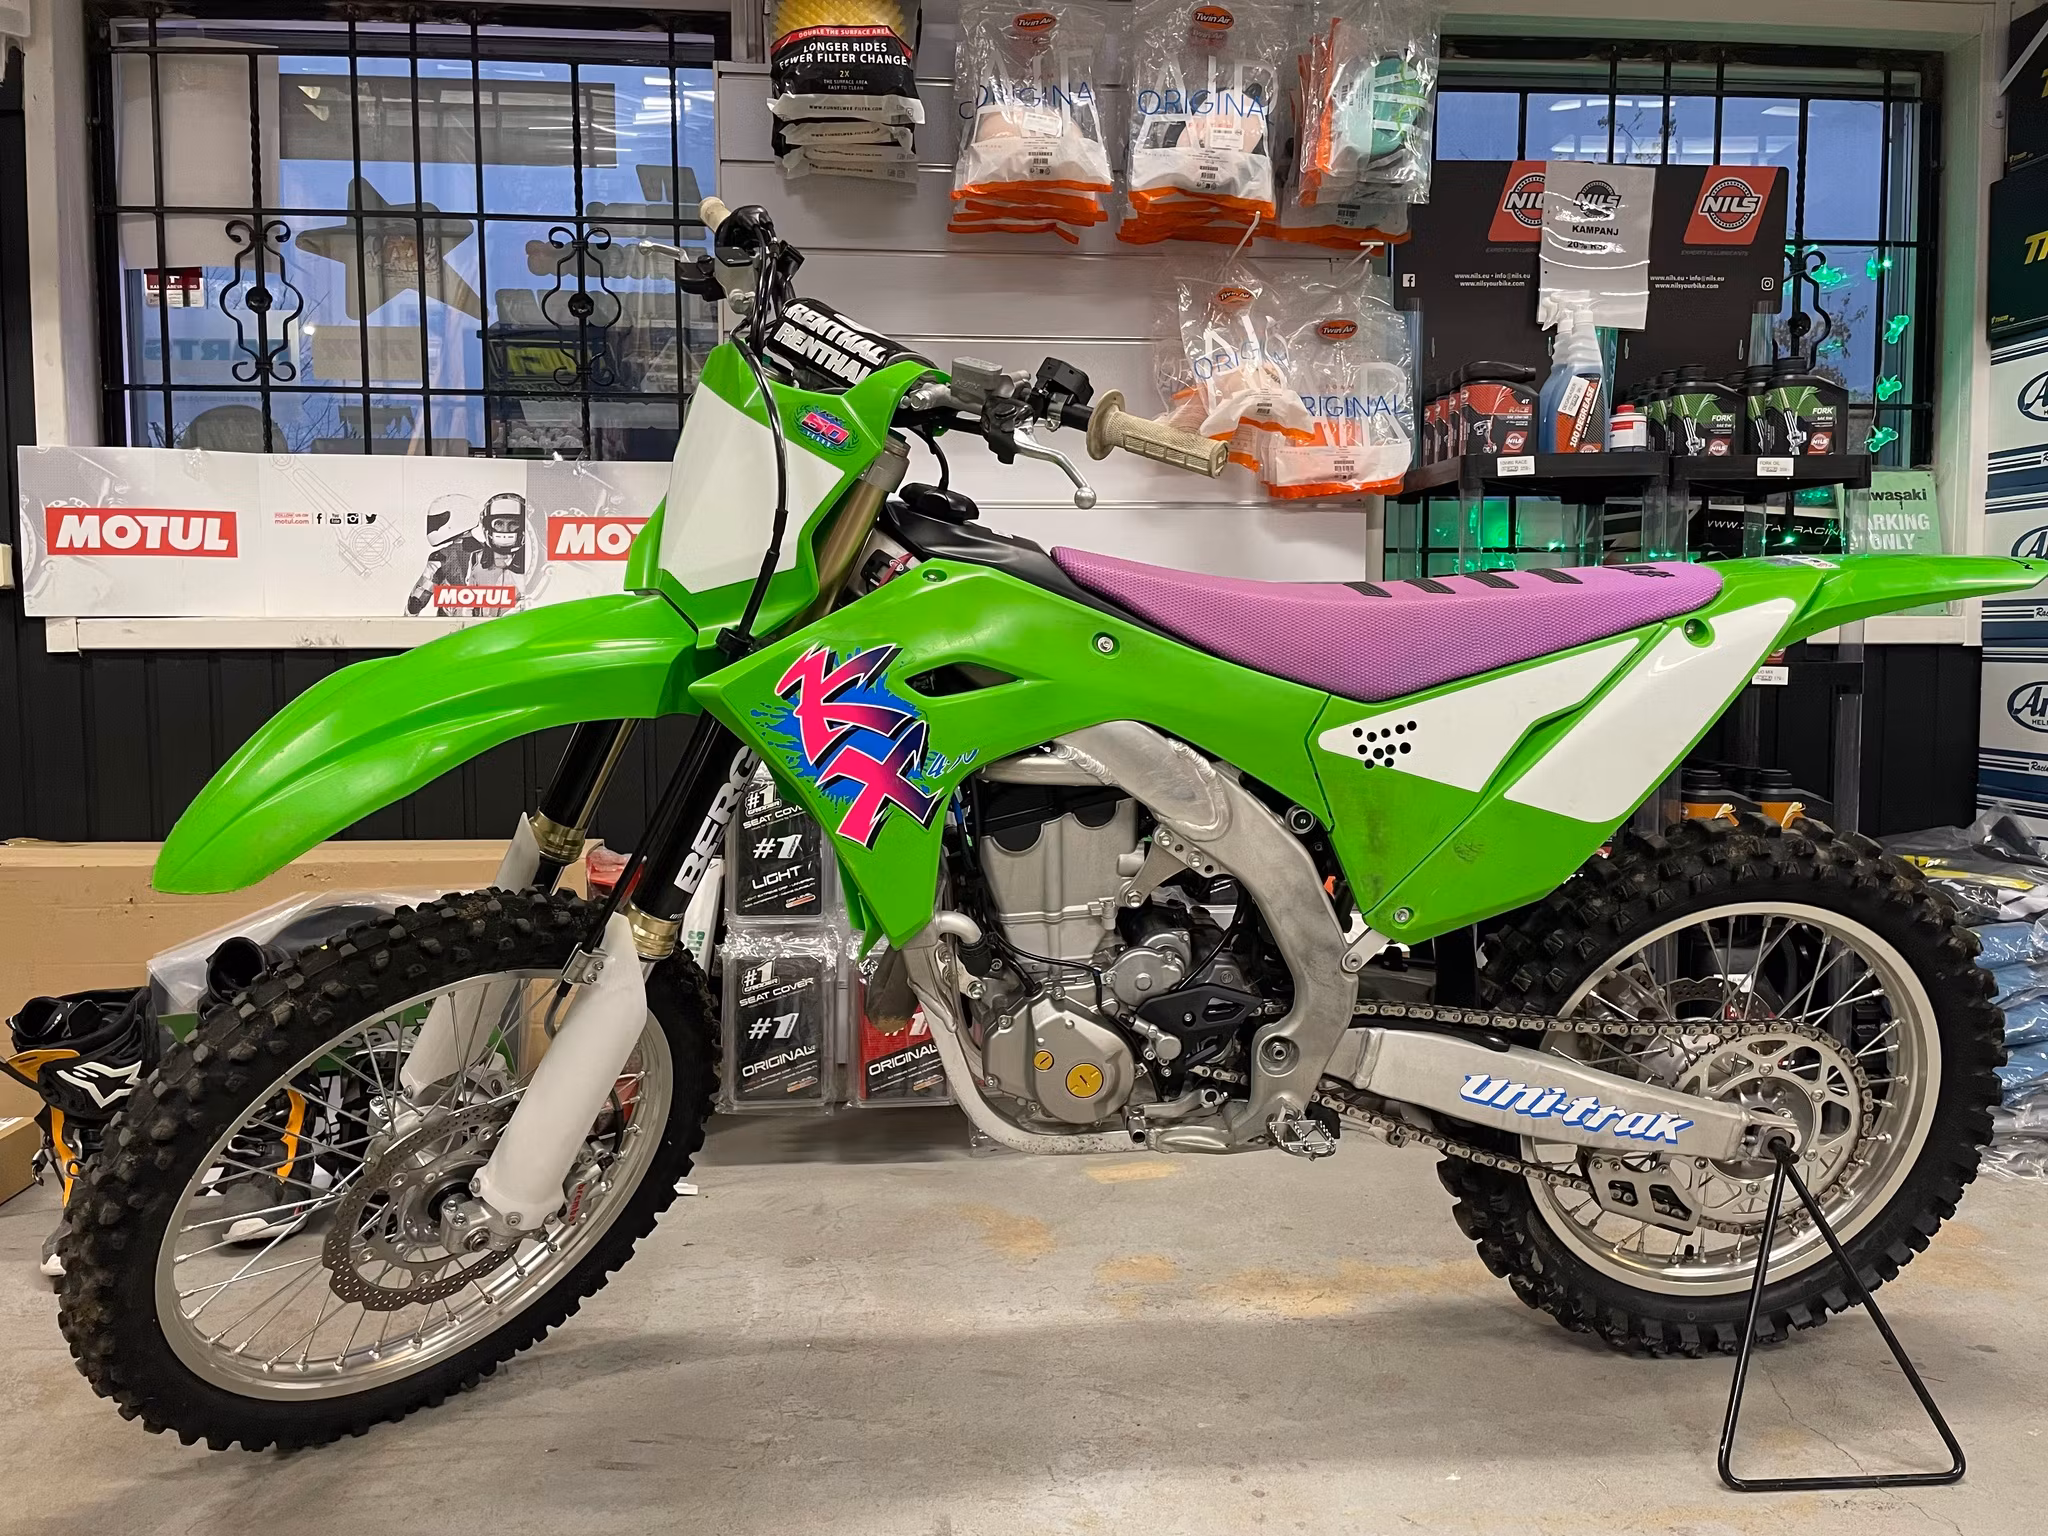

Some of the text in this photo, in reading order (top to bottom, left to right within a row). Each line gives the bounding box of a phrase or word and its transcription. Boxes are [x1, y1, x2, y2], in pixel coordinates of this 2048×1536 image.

[1018, 18, 1040, 27] Twin
[1195, 13, 1232, 25] Twin Air
[798, 26, 890, 39] DOUBLE THE SURFACE AREA
[803, 42, 887, 53] LONGER RIDES
[779, 53, 907, 70] FEWER FILTER CHANGE
[839, 70, 850, 78] 2X
[1701, 196, 1760, 213] NILS
[1572, 225, 1620, 236] KAMPANJ
[1460, 280, 1525, 288] www.nilsyourbike.com
[1655, 282, 1719, 290] www.nilsyourbike.com
[784, 303, 888, 366] RENTHAL
[1323, 327, 1342, 335] Twin
[1301, 394, 1408, 418] RIGINAL
[1570, 430, 1580, 448] 100
[1576, 385, 1596, 432] DEGREASE
[1711, 414, 1733, 422] FORK
[1812, 407, 1834, 415] FORK
[55, 514, 230, 551] MOTUL
[437, 588, 512, 606] MOTUL
[747, 784, 776, 810] #1
[742, 814, 773, 830] SEAT
[775, 804, 802, 819] COV
[752, 834, 803, 859] #1
[752, 864, 803, 890] LIGHT
[744, 960, 773, 987] #1
[739, 991, 770, 1007] SEAT
[772, 977, 814, 996] COVER
[748, 1012, 800, 1040] #1
[742, 1045, 816, 1077] ORIGINAL
[869, 1044, 938, 1076] ORIGINAL
[1460, 1073, 1694, 1145] uni-trak
[568, 1183, 587, 1222] brembo
